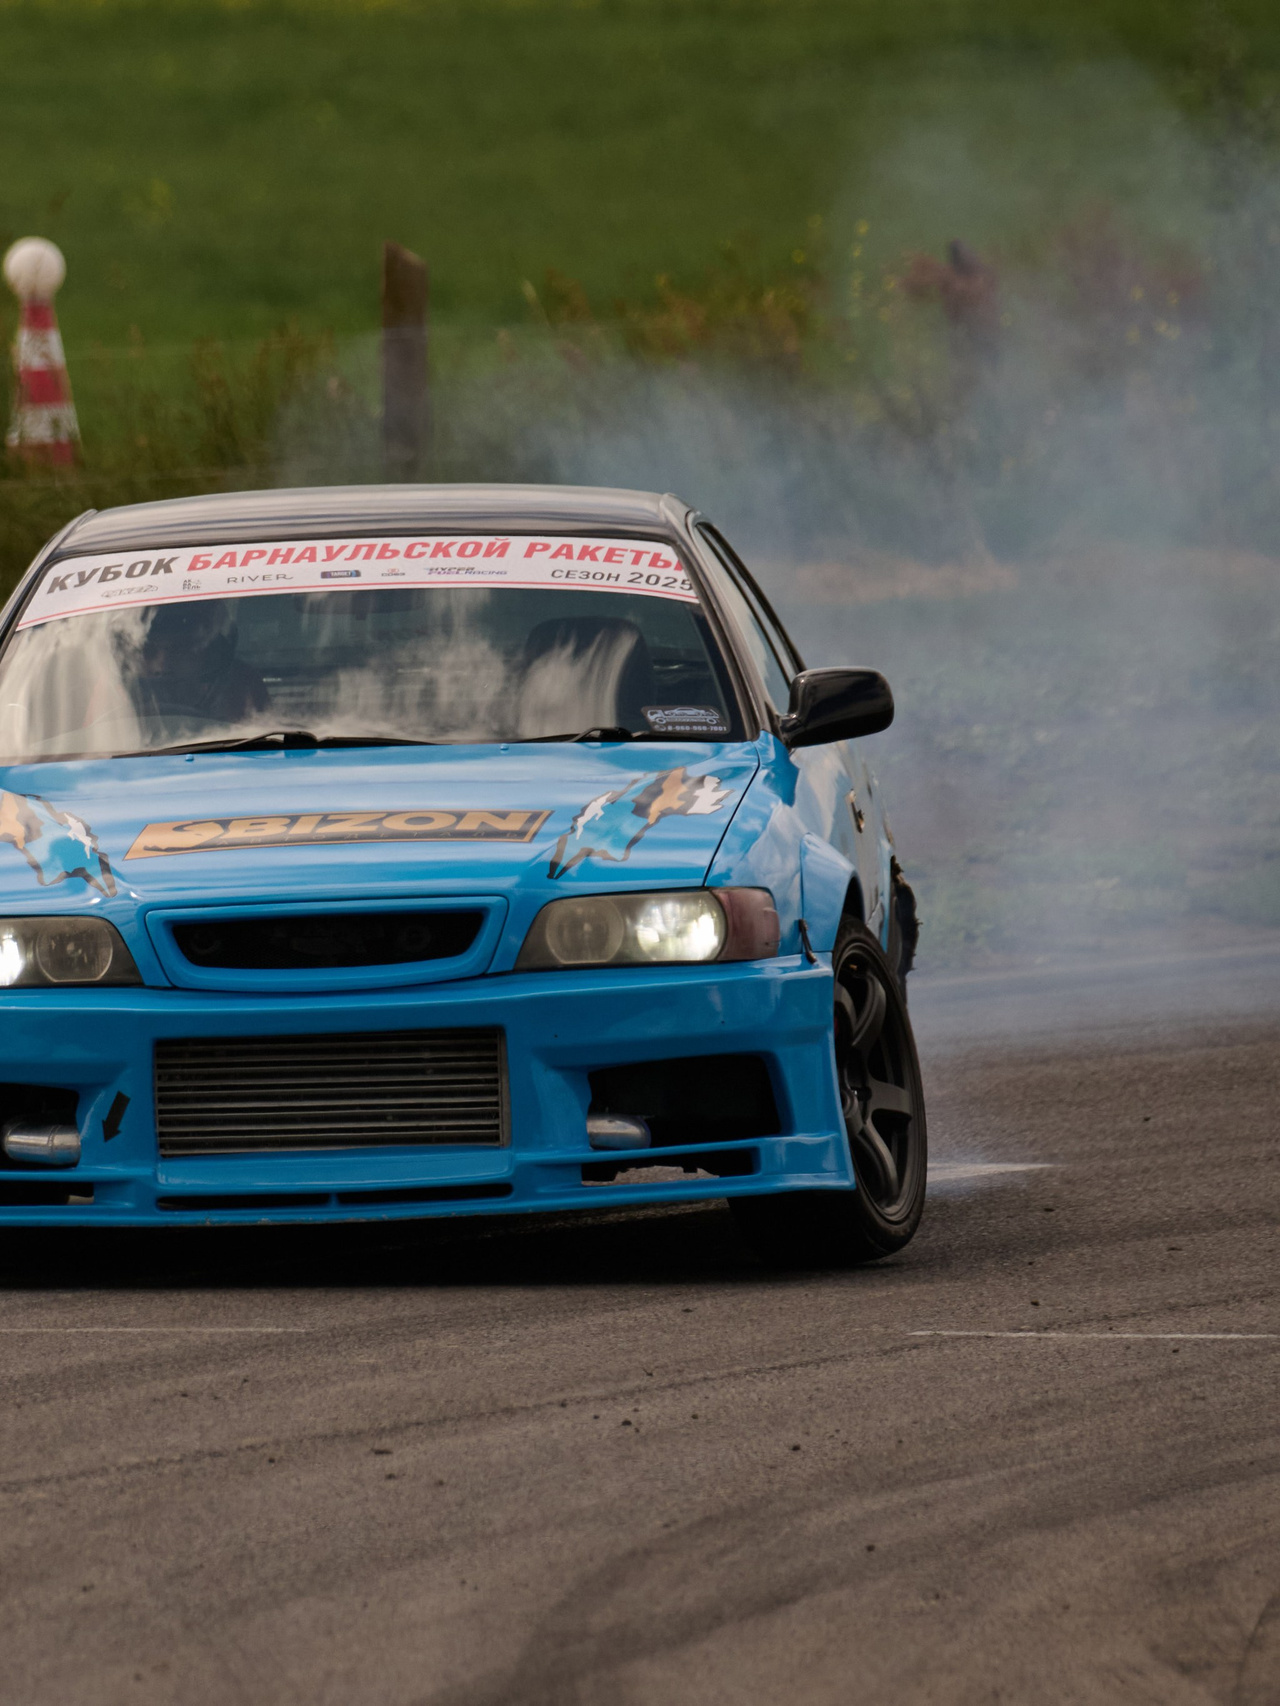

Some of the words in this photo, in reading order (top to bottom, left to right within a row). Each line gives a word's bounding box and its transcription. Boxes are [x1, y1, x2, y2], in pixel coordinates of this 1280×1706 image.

[47, 556, 180, 594] КУБОК
[187, 537, 511, 571] БАРНАУЛЬСКОЙ
[523, 541, 684, 572] РАКЕТЫ
[227, 573, 293, 584] RIVER
[551, 569, 620, 582] СЕЗОН
[627, 572, 694, 591] 2025
[219, 811, 532, 839] BIZON
